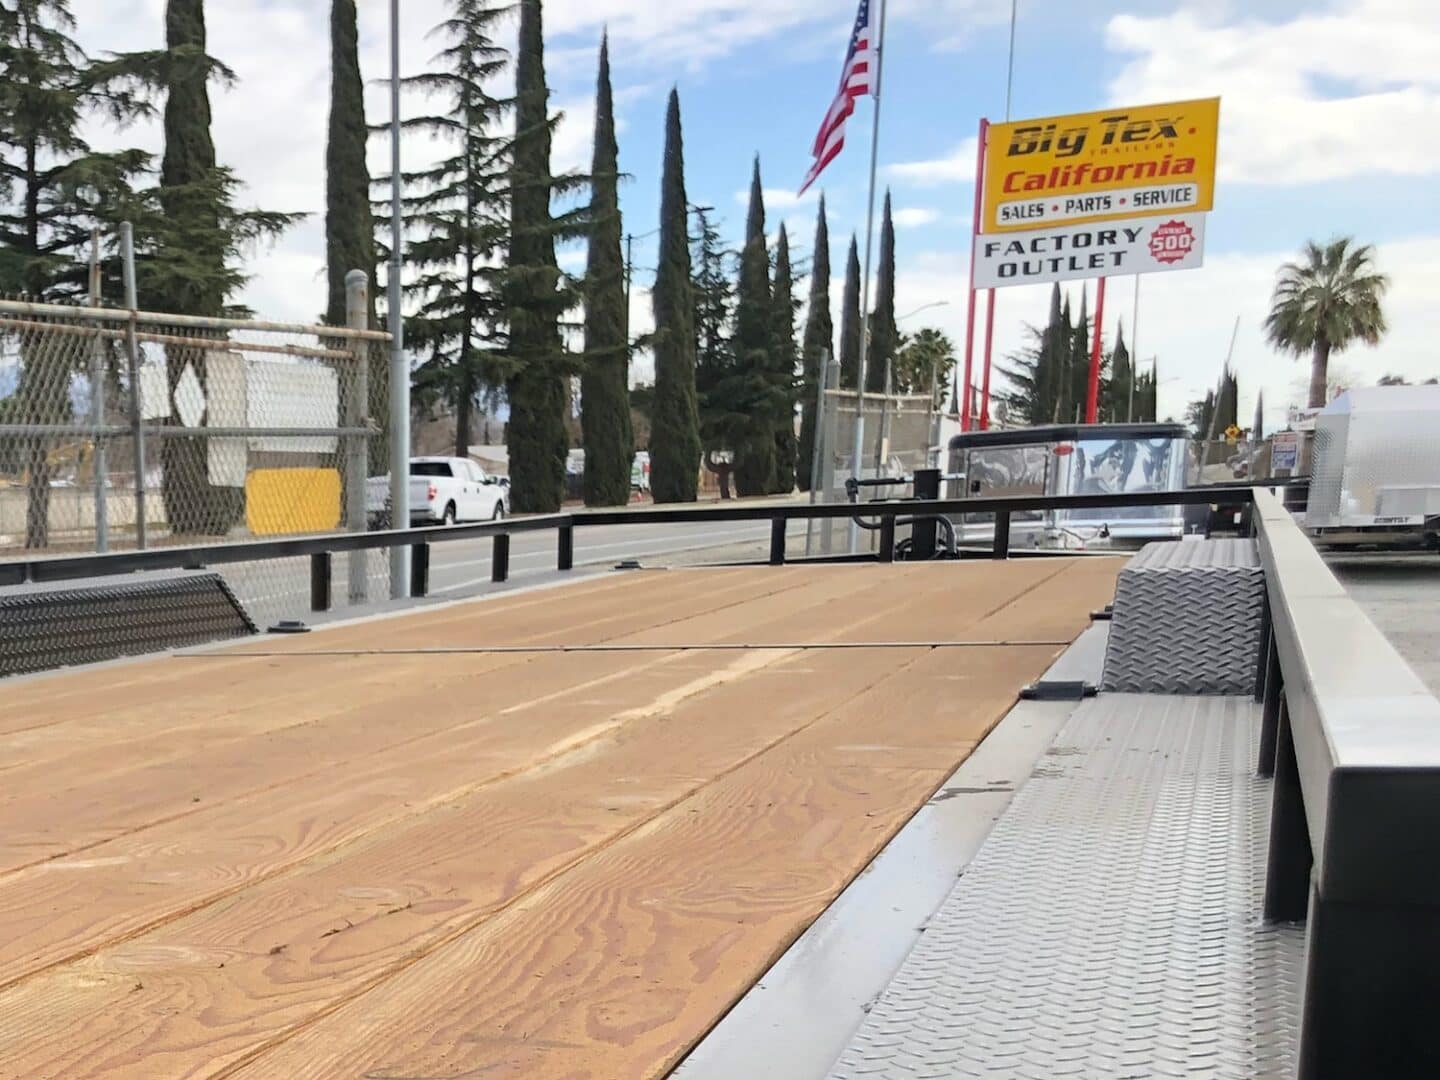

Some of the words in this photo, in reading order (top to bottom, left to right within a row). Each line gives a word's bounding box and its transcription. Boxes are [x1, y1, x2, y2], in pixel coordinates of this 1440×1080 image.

[1007, 124, 1089, 158] Big
[1100, 115, 1184, 145] Tex
[1002, 155, 1195, 193] California
[1001, 203, 1045, 221] SALES
[1065, 196, 1112, 214] PARTS
[1133, 187, 1192, 207] SERVICE
[984, 227, 1143, 257] FACTORY
[1152, 235, 1191, 251] 500
[997, 251, 1127, 278] OUTLET
